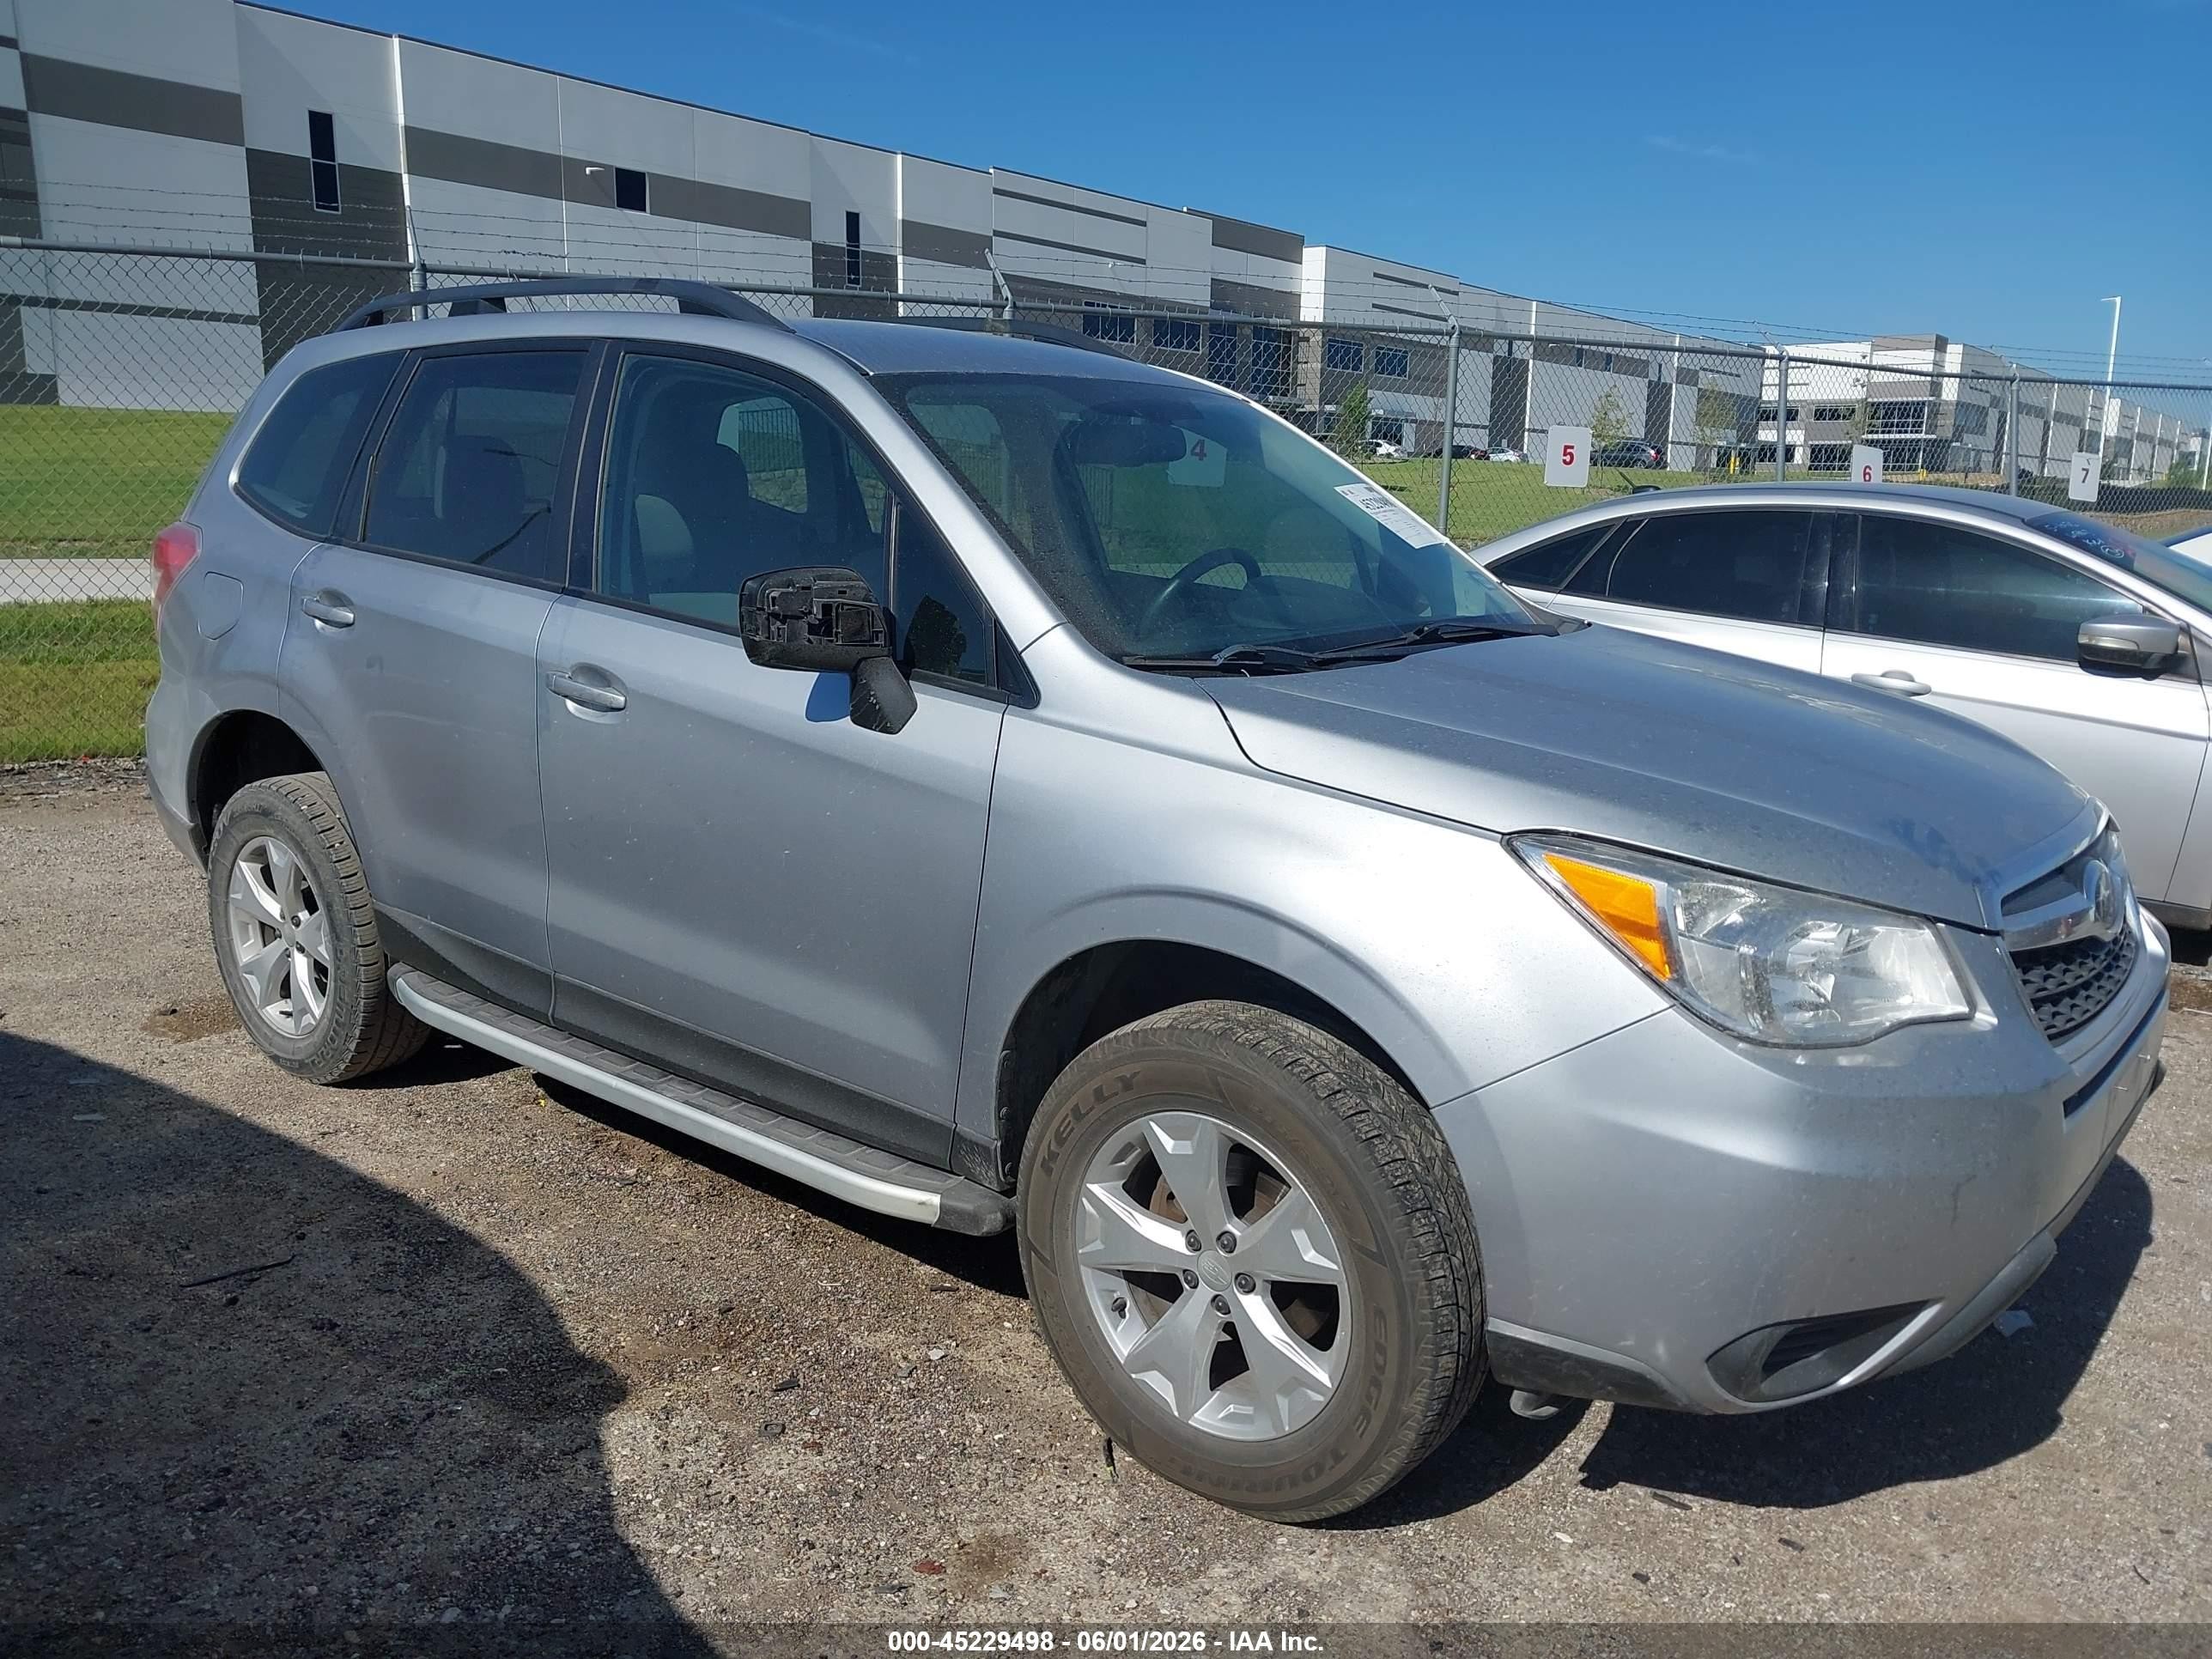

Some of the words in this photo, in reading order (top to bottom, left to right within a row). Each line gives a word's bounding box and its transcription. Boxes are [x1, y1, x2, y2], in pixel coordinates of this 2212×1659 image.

[1191, 440, 1207, 461] 4
[1562, 444, 1576, 466] 5
[1862, 465, 1873, 483] 6
[2081, 467, 2090, 484] 7
[1040, 1070, 1141, 1176] KELLY
[1353, 1303, 1388, 1439] EDGE
